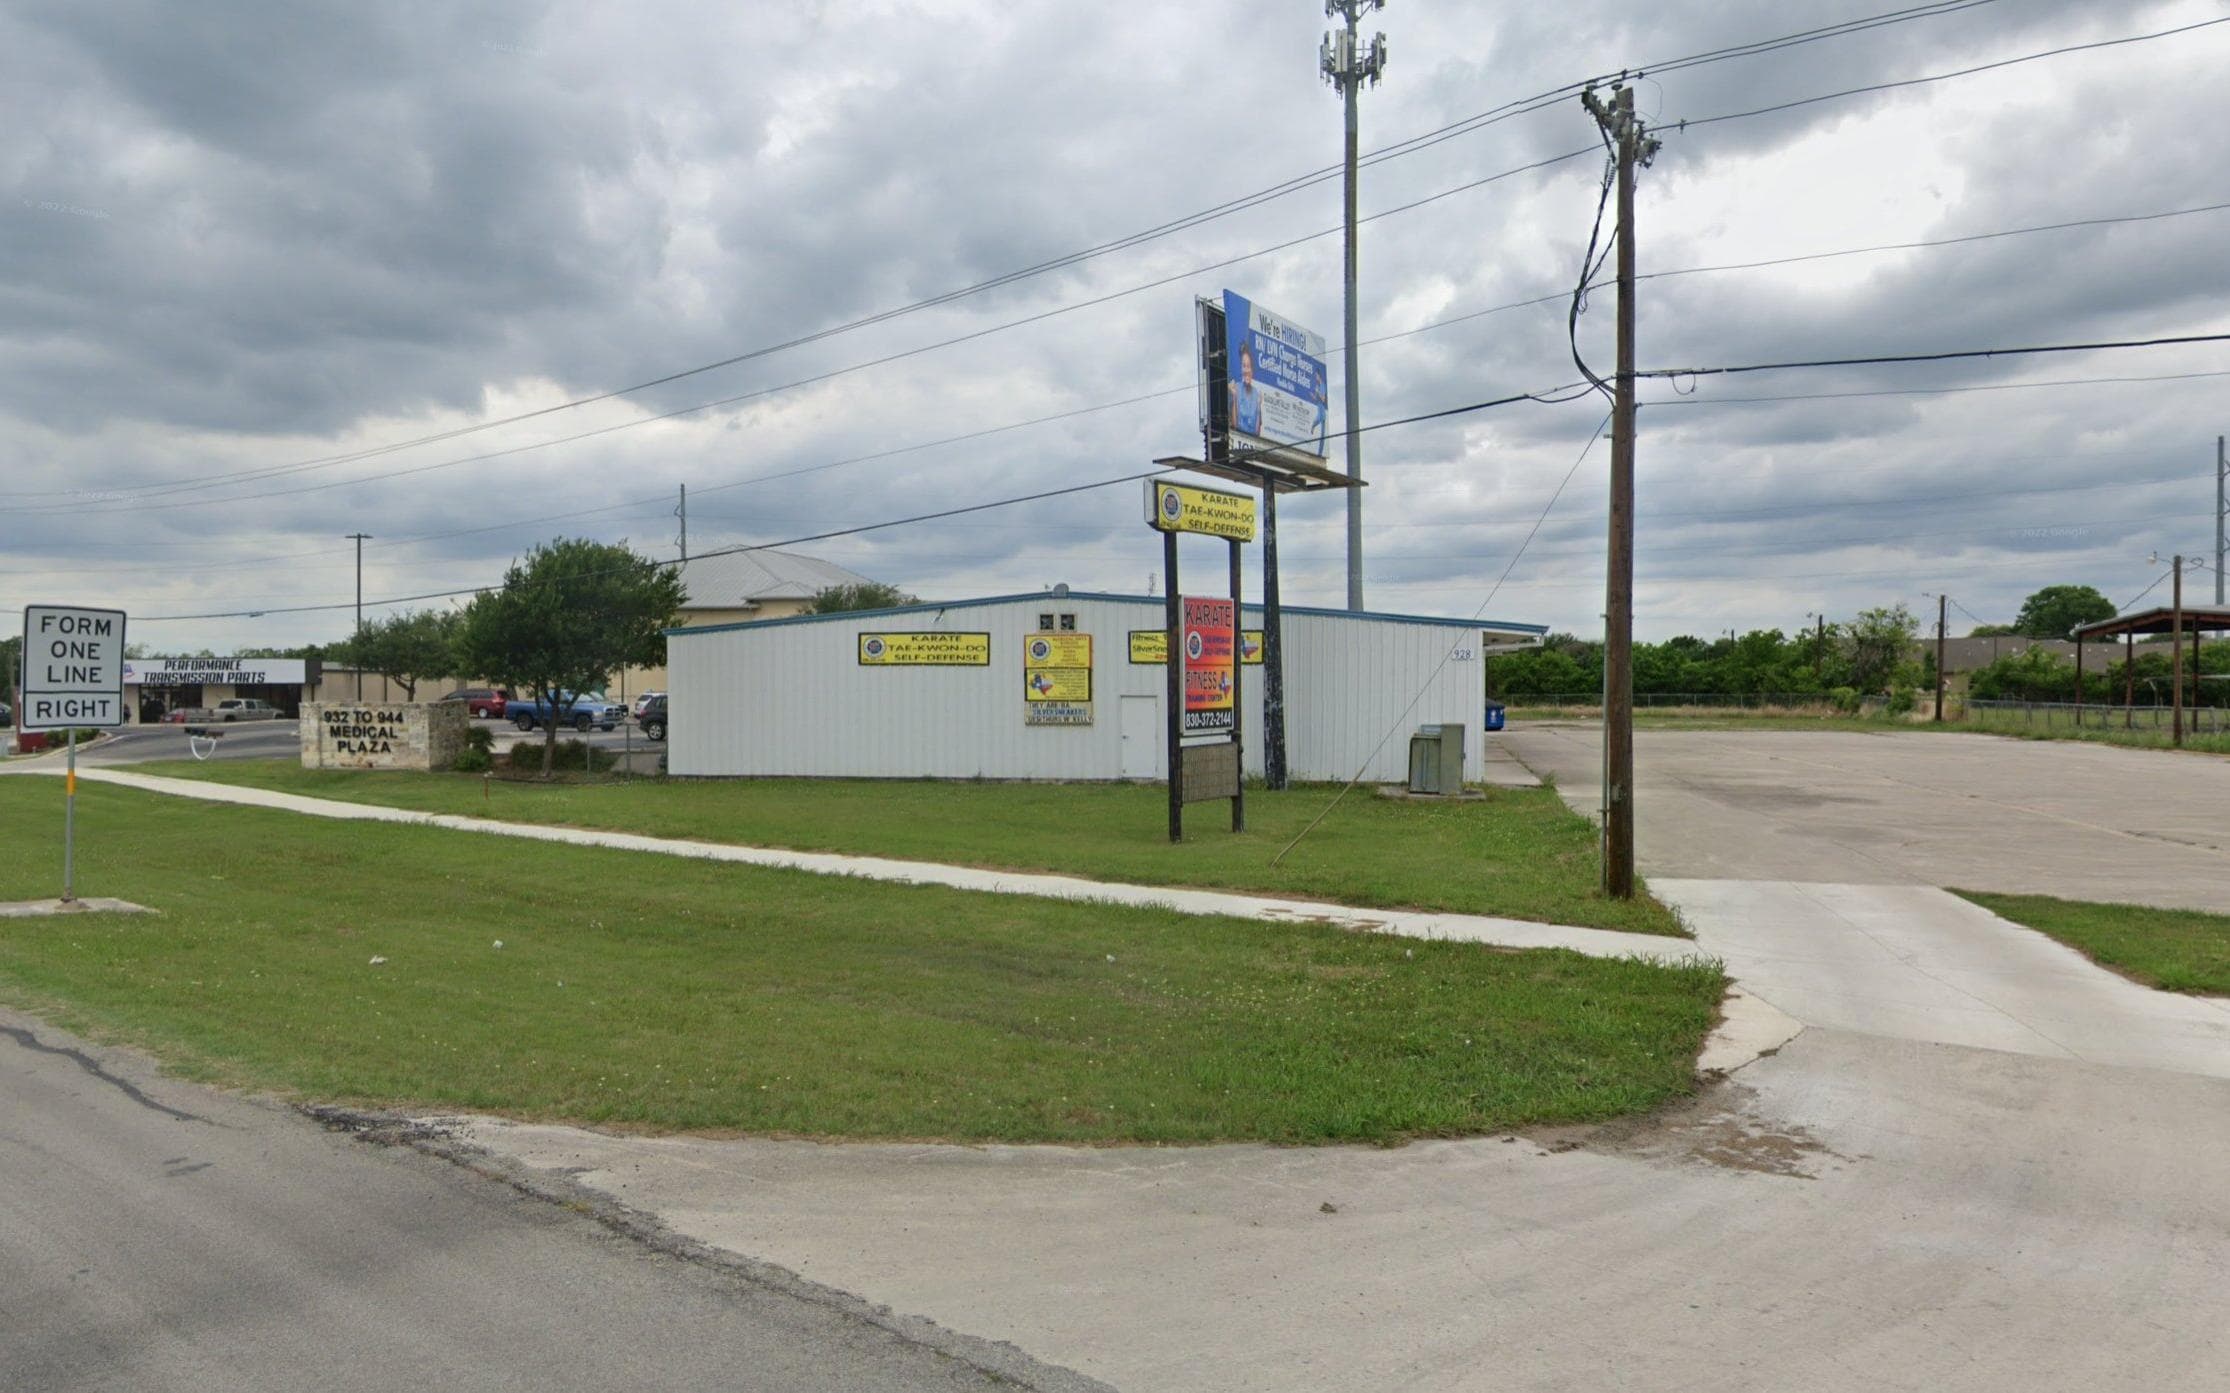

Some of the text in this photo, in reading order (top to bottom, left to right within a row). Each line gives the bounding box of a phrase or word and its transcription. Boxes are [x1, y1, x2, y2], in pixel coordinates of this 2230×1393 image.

[1259, 312, 1280, 339] We're
[1258, 352, 1282, 376] Certified
[1202, 493, 1239, 507] KARATE
[1183, 503, 1254, 523] TAE-KWON-DO
[1188, 519, 1250, 536] SELF-DEFENSE
[1185, 603, 1232, 628] KARATE
[41, 615, 111, 637] FORM
[51, 640, 101, 660] ONE
[888, 644, 986, 652] TAE-KWON-DO
[1453, 648, 1471, 660] 928
[47, 664, 102, 683] LINE
[164, 659, 243, 672] PERFORMANCE
[144, 672, 266, 684] TRANSMISSION PARTS
[1185, 671, 1217, 690] FITNESS
[36, 699, 110, 719] RIGHT
[324, 711, 404, 724] 932 TO 944
[1186, 711, 1232, 729] 830-372-2144
[330, 726, 398, 739] MEDICAL
[337, 741, 391, 753] PLAZA
